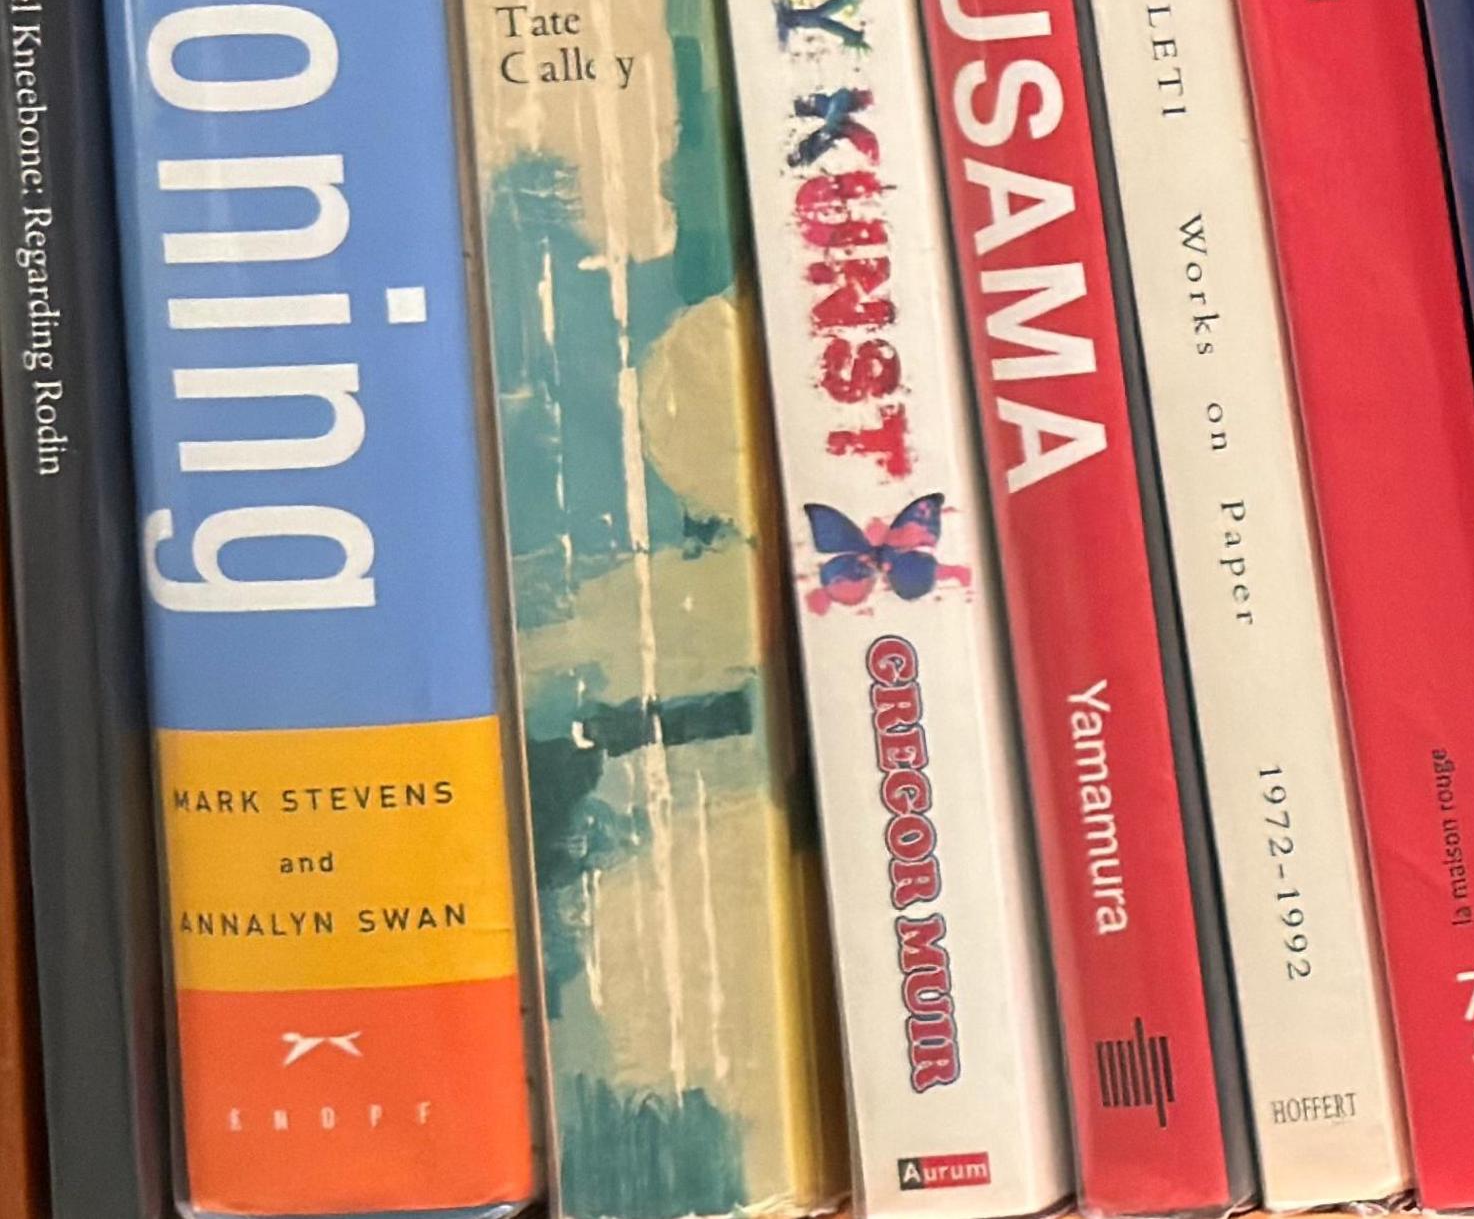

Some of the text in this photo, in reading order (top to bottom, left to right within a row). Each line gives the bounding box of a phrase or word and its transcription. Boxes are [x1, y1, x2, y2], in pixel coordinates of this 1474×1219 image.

[495, 4, 582, 38] Tate
[1148, 3, 1187, 120] LETI
[12, 24, 48, 195] Kneebone:
[16, 206, 61, 371] Regarding
[788, 82, 918, 484] KUNST
[33, 380, 69, 476] Rodin
[1177, 214, 1255, 628] Works on Paper
[173, 781, 454, 813] MARK STEVENS
[1066, 680, 1131, 936] Yamamura
[280, 851, 336, 874] and
[863, 635, 963, 1096] GREGOR MUIR
[1258, 765, 1312, 982] 1972-1992
[180, 903, 467, 937] ANNALYN SWAN
[228, 1100, 432, 1133] KNOPF
[1270, 1091, 1358, 1125] HOFFERT
[901, 1154, 990, 1187] Aurum
